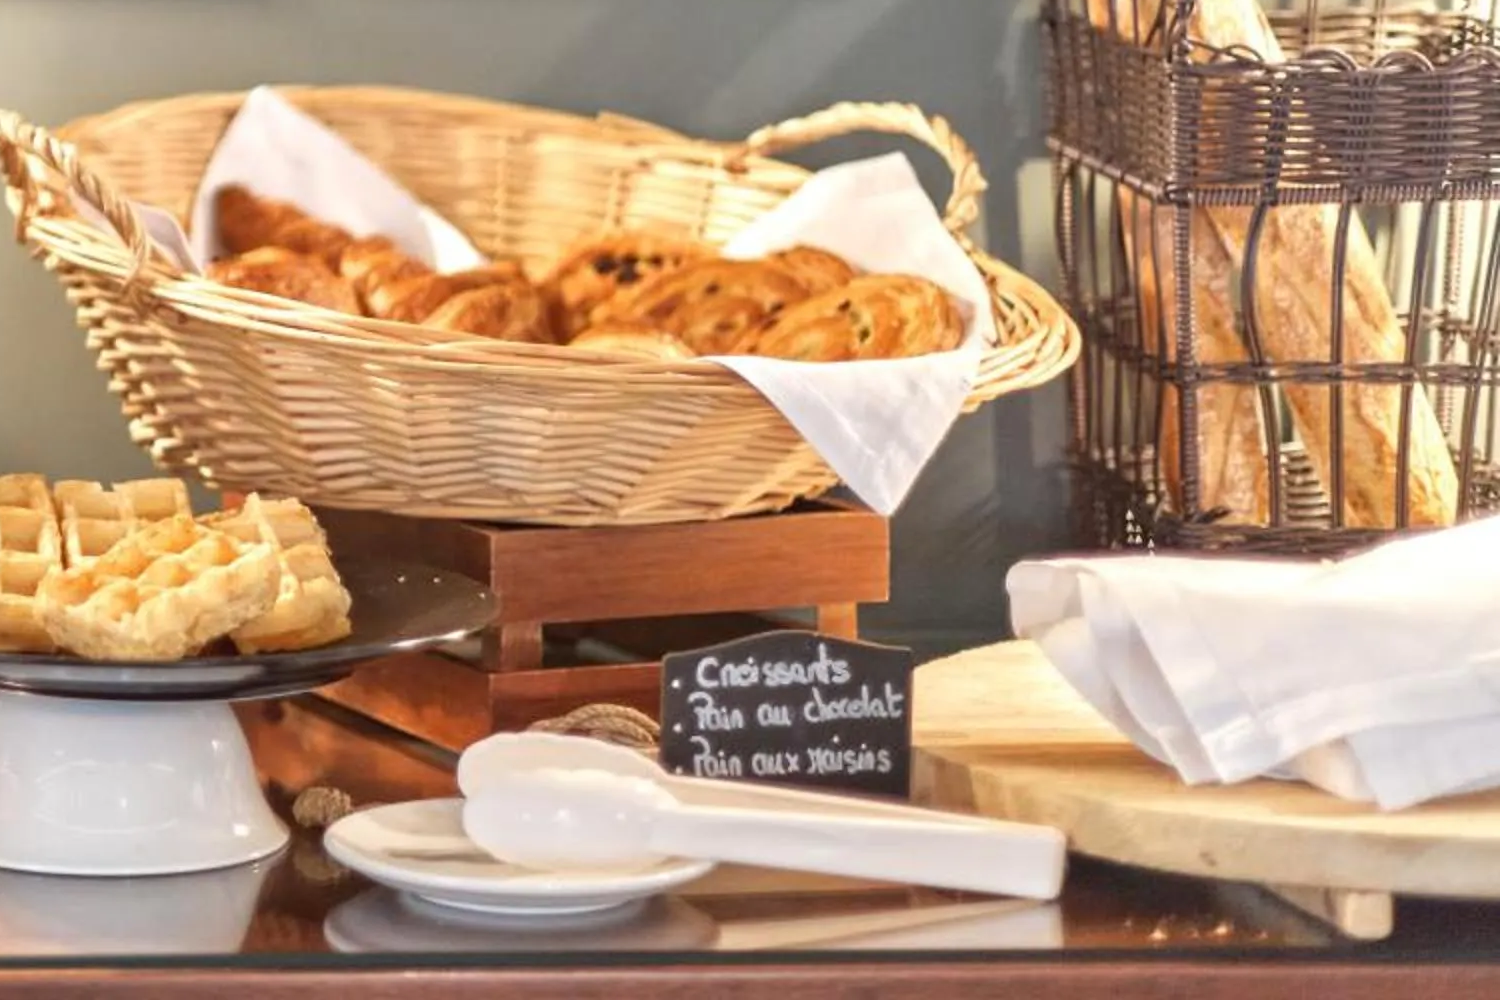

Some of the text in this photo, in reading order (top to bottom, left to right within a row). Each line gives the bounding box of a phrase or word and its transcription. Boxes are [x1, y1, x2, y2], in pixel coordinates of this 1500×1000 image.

[695, 643, 851, 688] Croissants
[687, 681, 904, 731] Pain au chocolat
[689, 735, 741, 777] Pain
[751, 752, 799, 776] aux
